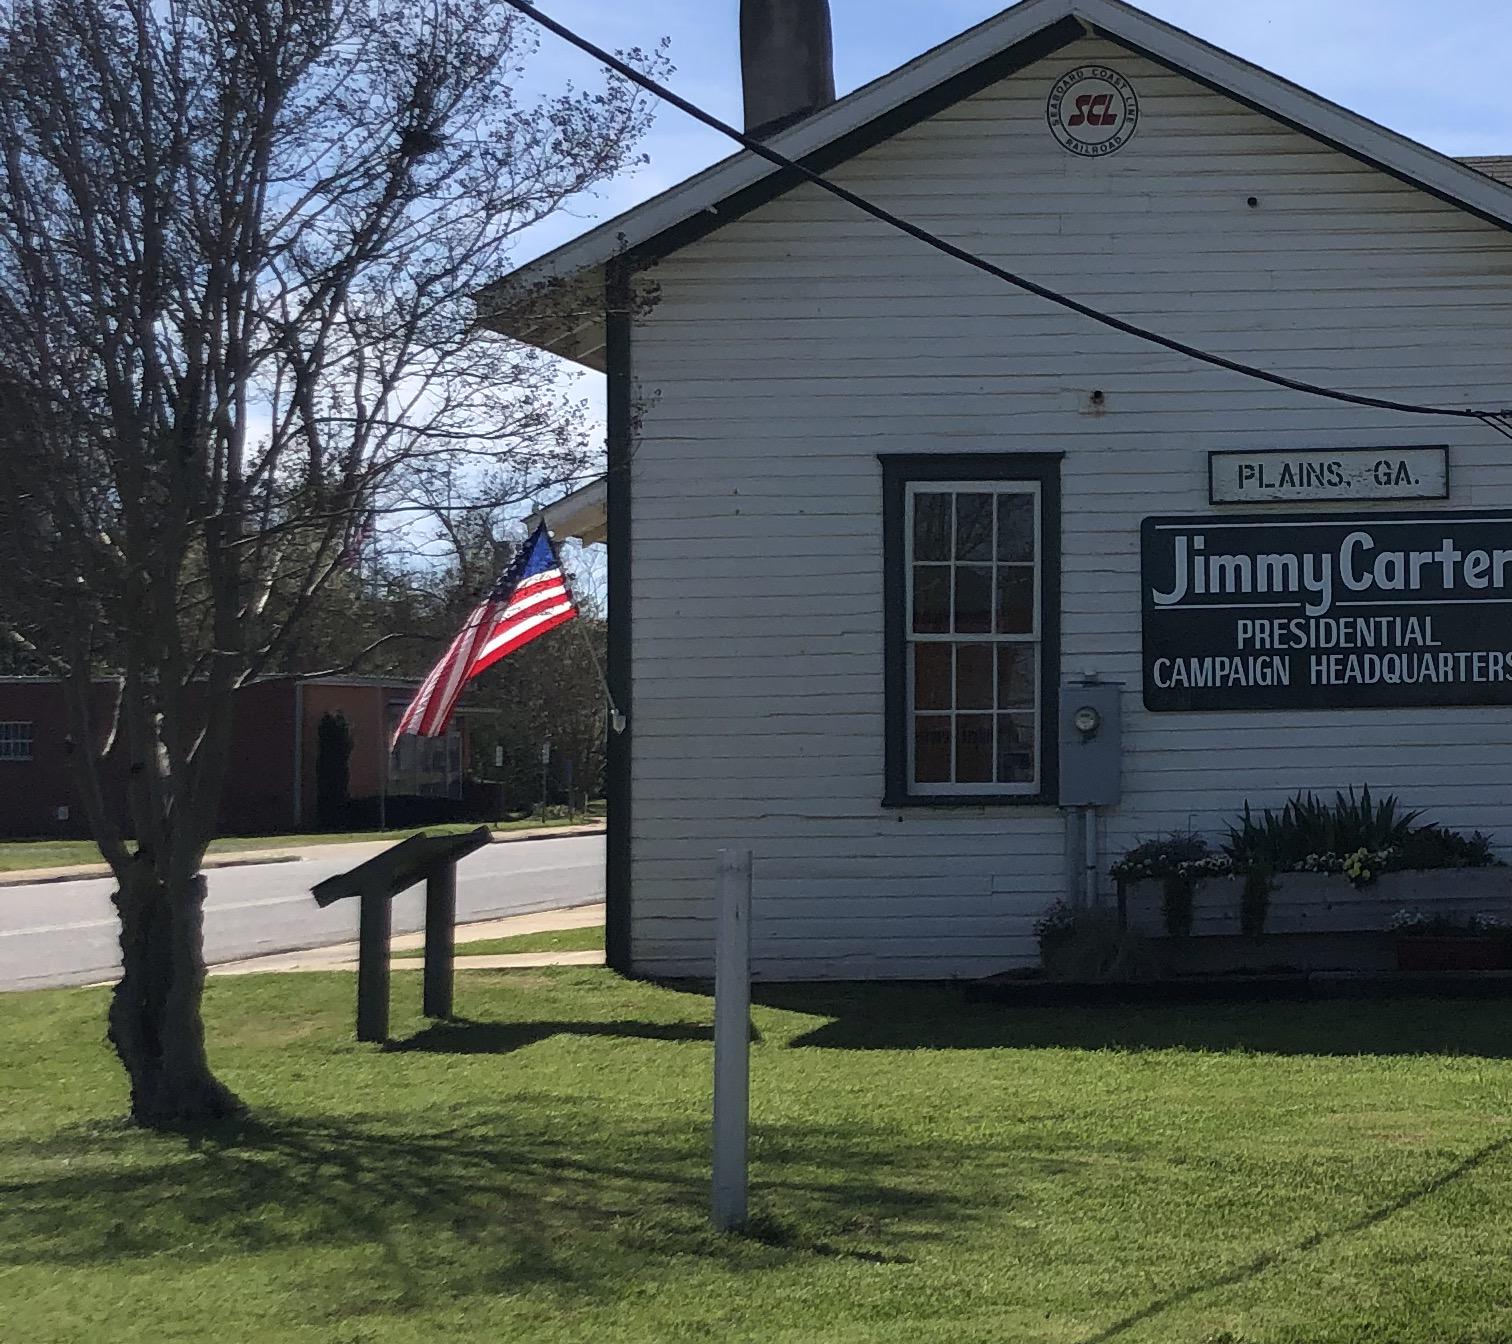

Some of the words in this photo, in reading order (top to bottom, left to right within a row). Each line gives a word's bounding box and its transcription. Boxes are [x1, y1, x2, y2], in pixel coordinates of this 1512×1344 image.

[1067, 94, 1118, 126] SCL
[1092, 69, 1127, 90] COAST
[1125, 96, 1137, 125] LINE
[1065, 136, 1122, 154] RAILROAD
[1237, 461, 1352, 490] PLAINS,
[1373, 459, 1420, 487] GA.
[1152, 535, 1333, 617] Jimmy
[1237, 616, 1442, 650] PRESIDENTIAL
[1153, 655, 1290, 689] CAMPAIGN
